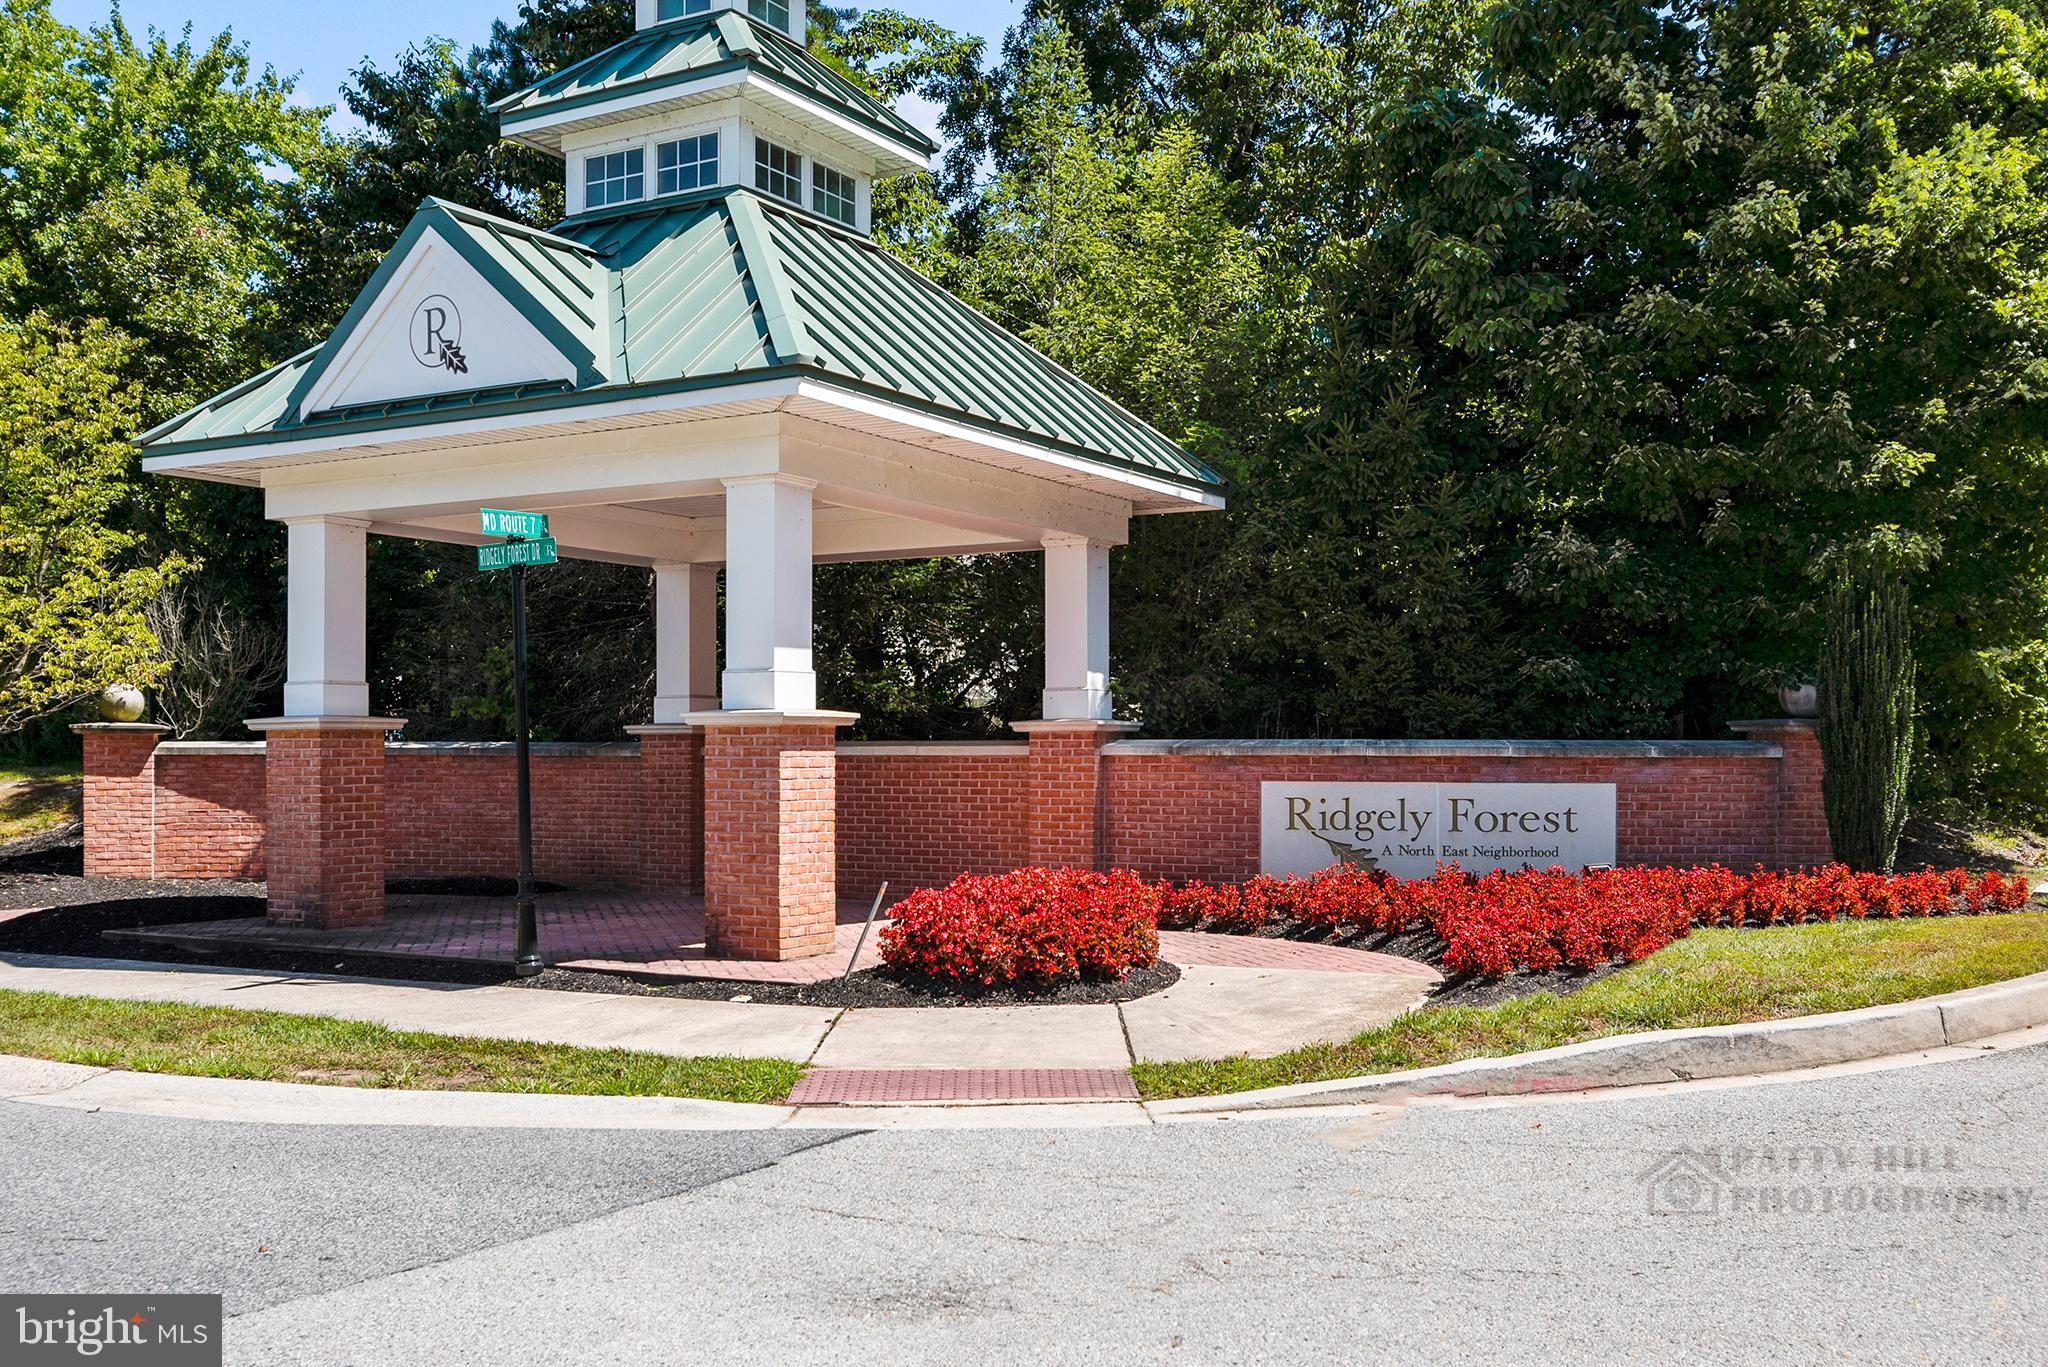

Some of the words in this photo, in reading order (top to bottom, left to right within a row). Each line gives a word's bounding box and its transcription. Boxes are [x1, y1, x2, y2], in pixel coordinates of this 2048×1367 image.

[482, 512, 497, 531] MD
[499, 514, 528, 534] ROUTE
[529, 517, 536, 535] 7
[479, 546, 505, 566] RIDGELY
[507, 544, 530, 563] FOREST
[532, 543, 540, 561] DR
[1285, 796, 1432, 842] Ridgely
[1448, 798, 1579, 833] Forest
[1381, 845, 1393, 857] A
[1399, 845, 1435, 857] North
[1441, 845, 1469, 857] East
[1472, 845, 1560, 861] Neighborhood
